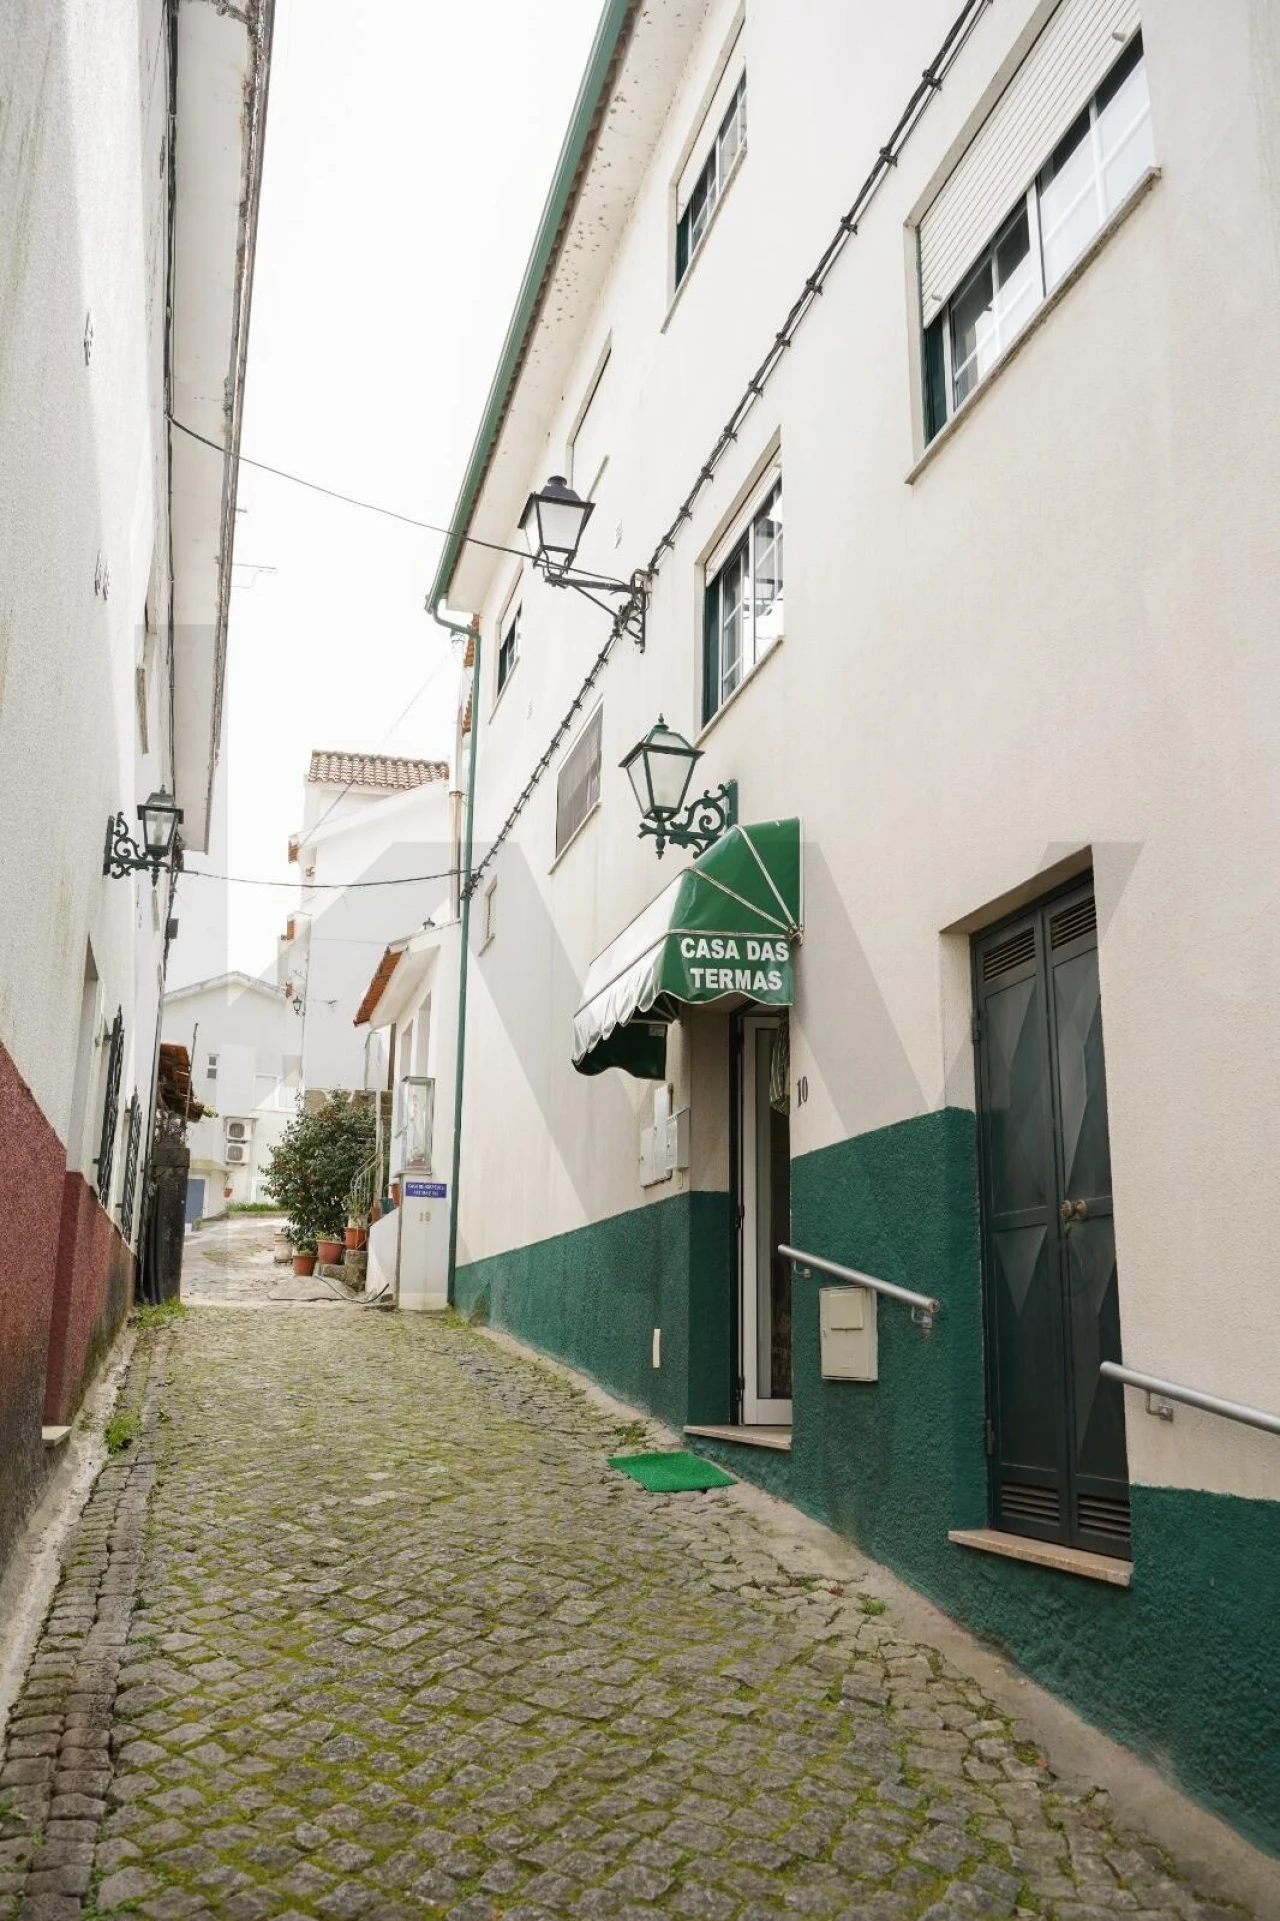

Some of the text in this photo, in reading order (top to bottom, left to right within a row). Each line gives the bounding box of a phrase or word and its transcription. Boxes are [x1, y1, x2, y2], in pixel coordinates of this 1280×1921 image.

[681, 938, 790, 962] CASA DAS
[690, 968, 783, 990] TERMAS
[797, 1076, 808, 1108] 10
